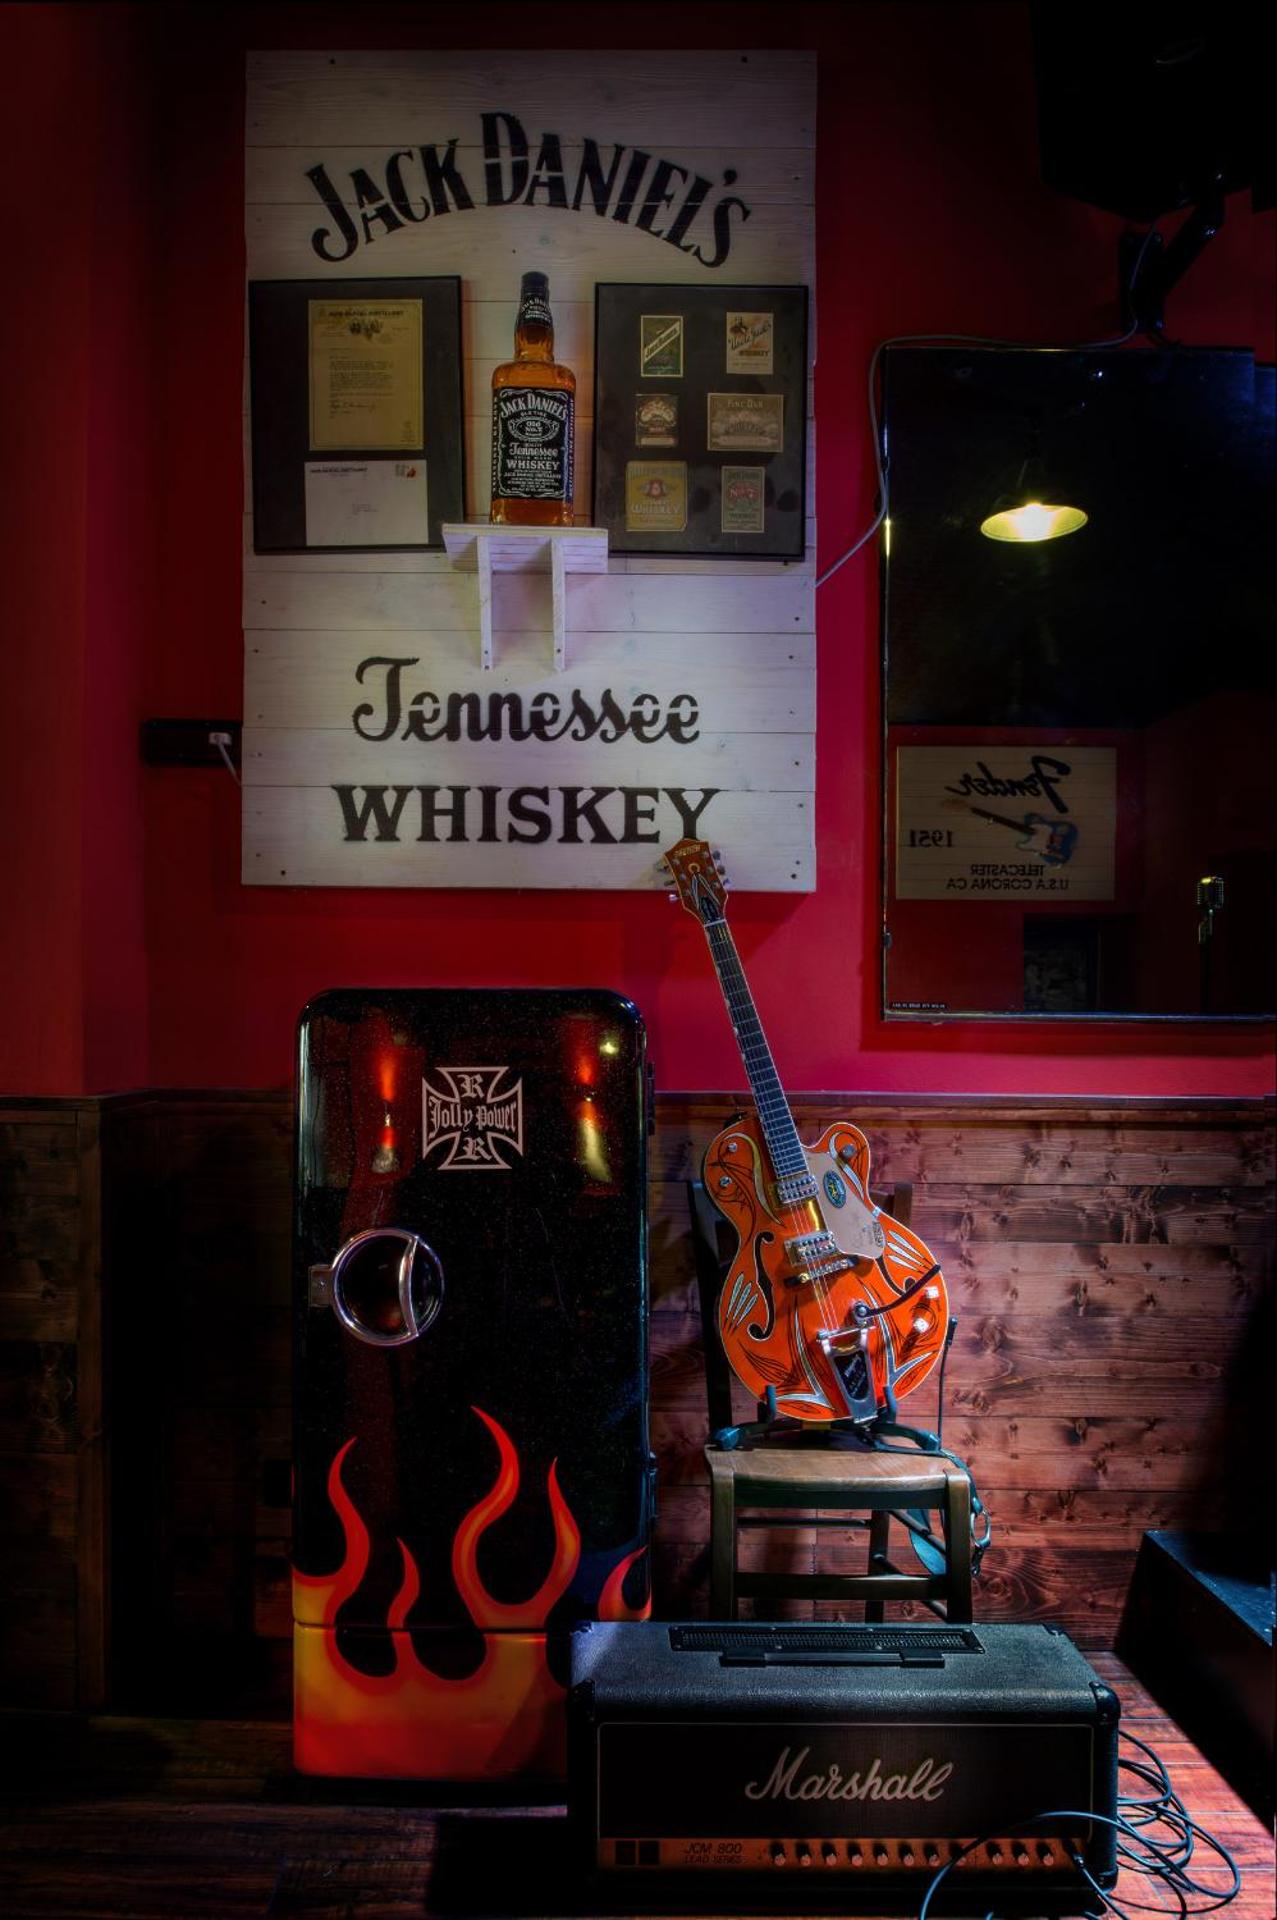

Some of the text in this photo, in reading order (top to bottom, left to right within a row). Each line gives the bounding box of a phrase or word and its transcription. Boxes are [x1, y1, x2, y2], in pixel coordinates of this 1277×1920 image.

[306, 112, 751, 268] JACK DANIEL'S
[500, 397, 525, 418] JACK
[509, 442, 559, 457] Tennessee
[506, 459, 561, 471] WHISKEY
[352, 656, 700, 744] Tennessee
[331, 785, 722, 844] WHISKEY
[457, 1073, 485, 1099] R
[428, 1096, 474, 1140] Jolly
[454, 1137, 493, 1161] R
[745, 1745, 954, 1801] Marshall
[717, 1842, 743, 1855] 800
